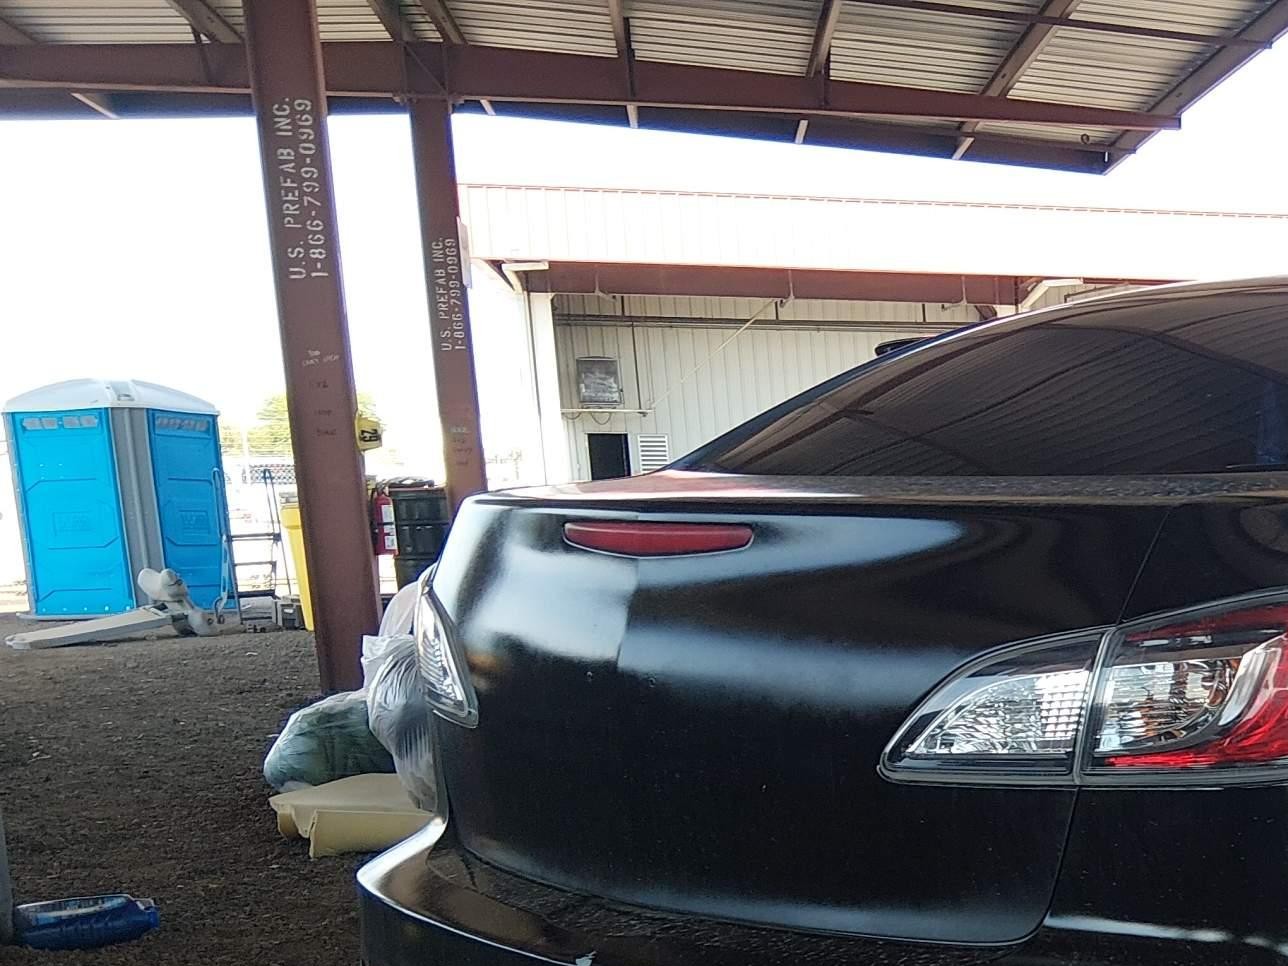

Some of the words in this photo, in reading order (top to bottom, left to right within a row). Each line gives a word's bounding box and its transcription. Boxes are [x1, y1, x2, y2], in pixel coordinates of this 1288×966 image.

[272, 97, 293, 136] INC.
[277, 148, 302, 228] PREFAB
[293, 99, 329, 277] 1-866-799-0969
[287, 241, 307, 279] U.S.
[431, 237, 445, 262] INC.
[433, 269, 450, 319] PREFAB
[444, 238, 467, 350] 1-866-799-0969
[440, 326, 453, 351] U.S.
